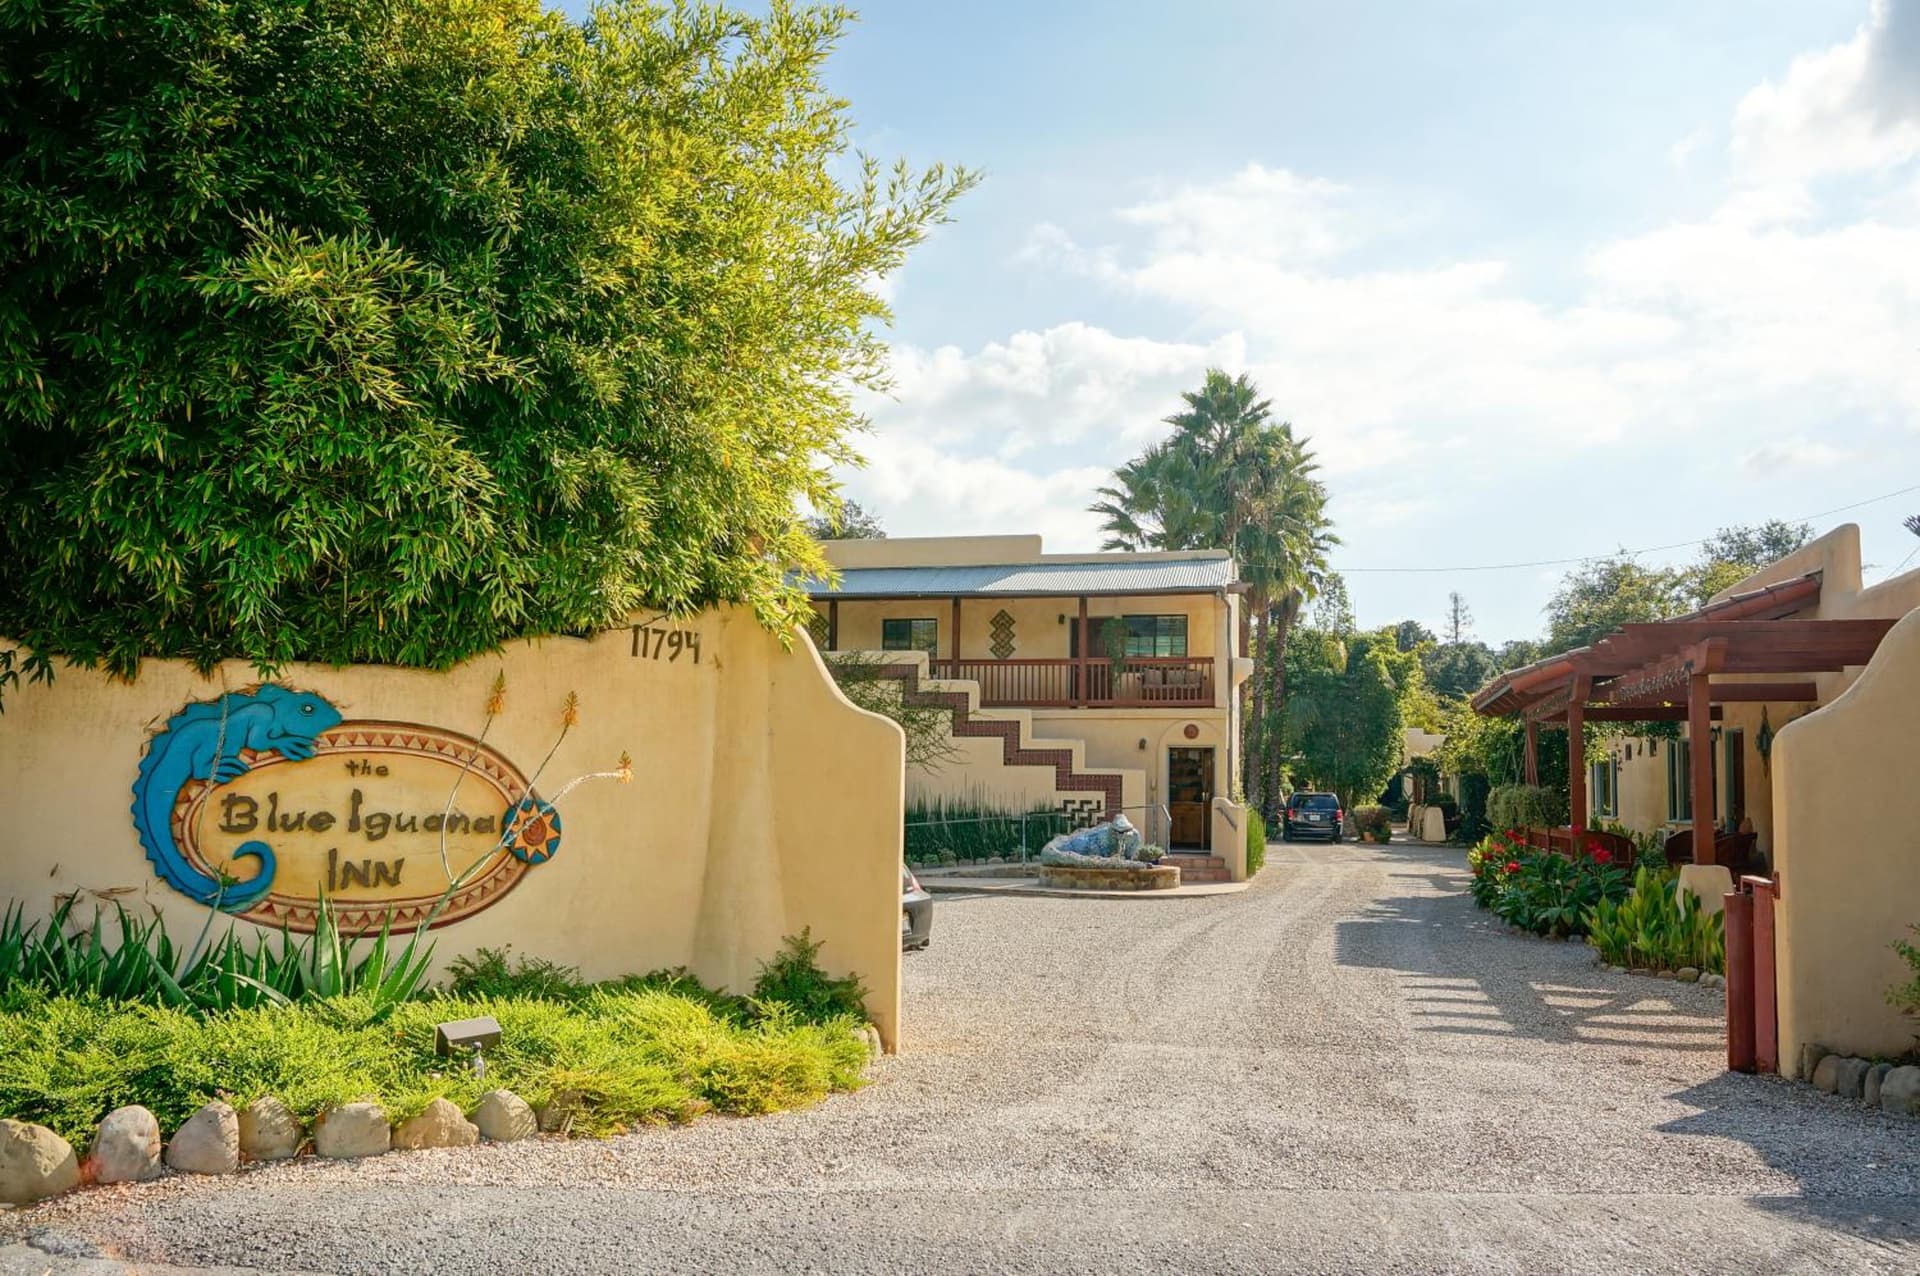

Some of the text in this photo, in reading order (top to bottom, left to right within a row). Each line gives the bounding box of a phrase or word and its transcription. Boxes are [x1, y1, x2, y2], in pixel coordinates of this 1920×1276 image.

[631, 624, 700, 665] 11794
[344, 759, 390, 777] the
[218, 788, 496, 842] Blue Iguana
[327, 848, 405, 892] INN
